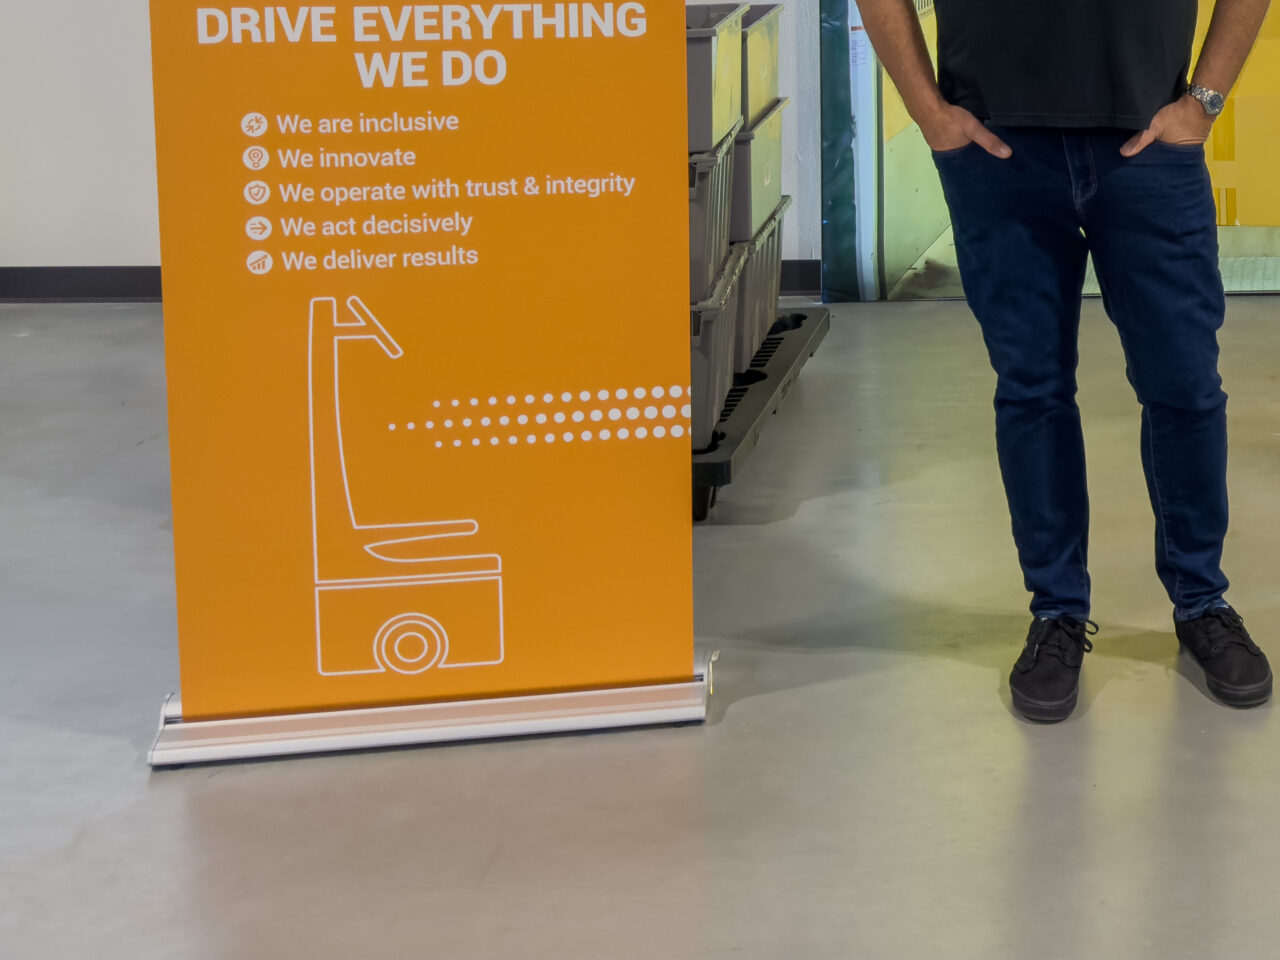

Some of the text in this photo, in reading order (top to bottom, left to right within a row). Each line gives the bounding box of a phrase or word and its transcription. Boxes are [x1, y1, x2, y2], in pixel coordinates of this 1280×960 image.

[196, 1, 647, 45] DRIVE EVERYTHING
[353, 49, 507, 89] WE DO
[275, 110, 459, 134] We are inclusive
[277, 147, 417, 169] We innovate
[278, 172, 636, 207] We operate with trust & integrity
[279, 211, 473, 237] We act decisively
[281, 244, 479, 271] We deliver results
